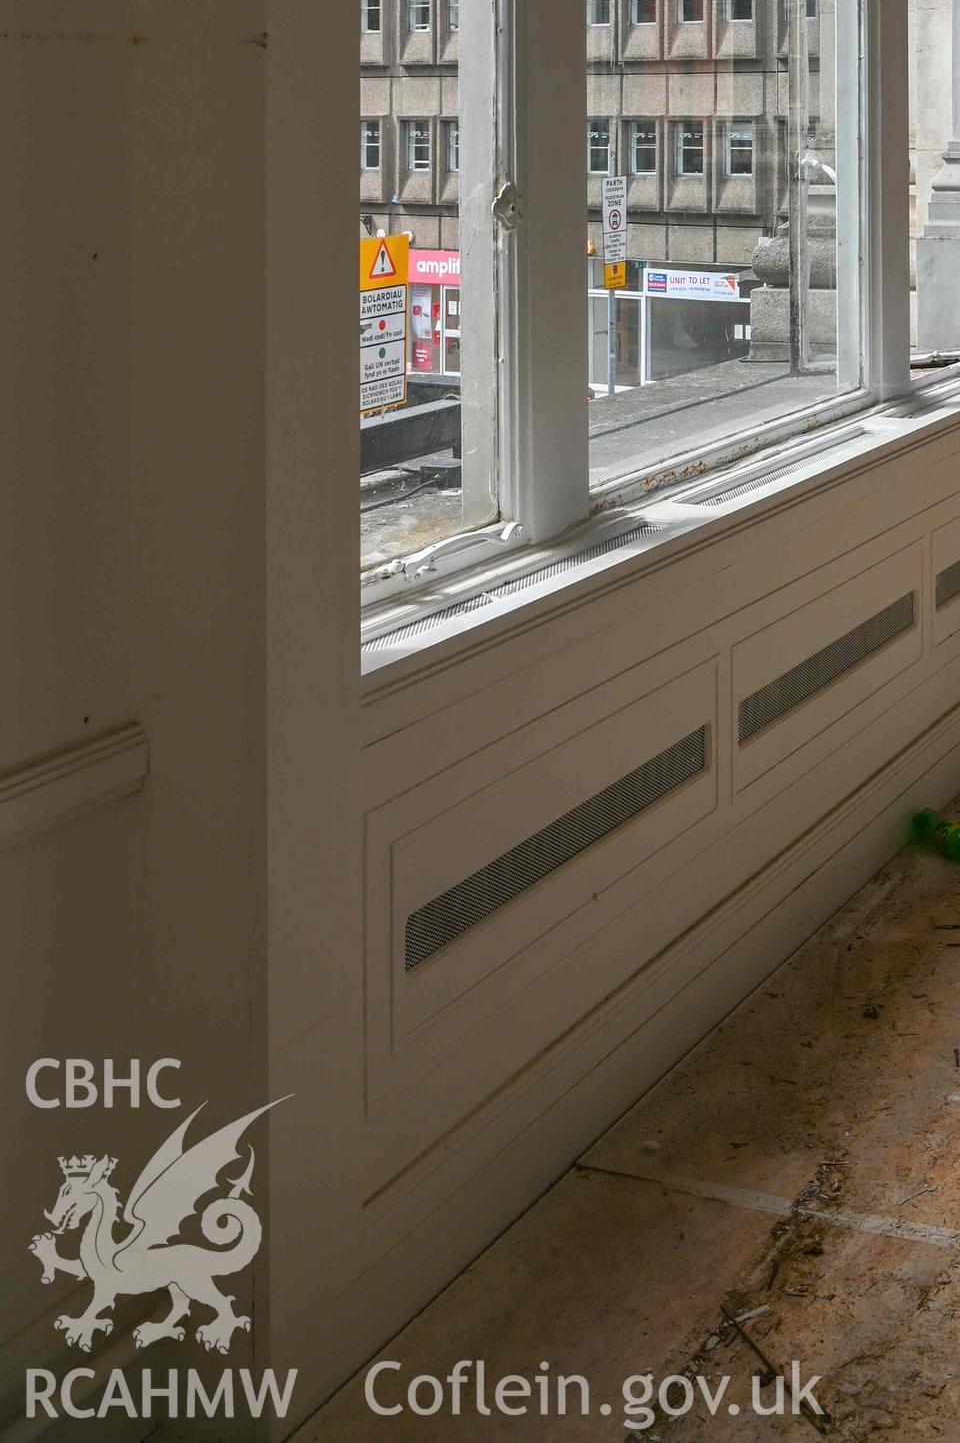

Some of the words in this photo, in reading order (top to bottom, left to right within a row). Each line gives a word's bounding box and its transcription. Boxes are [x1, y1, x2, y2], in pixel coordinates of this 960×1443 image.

[606, 179, 623, 187] PARTH
[607, 198, 622, 207] ZONE
[669, 276, 686, 285] UNIT
[688, 276, 698, 285] TO
[699, 277, 711, 285] LET
[362, 290, 403, 304] BOLARDIAU
[361, 299, 403, 315] AWTOMATIG
